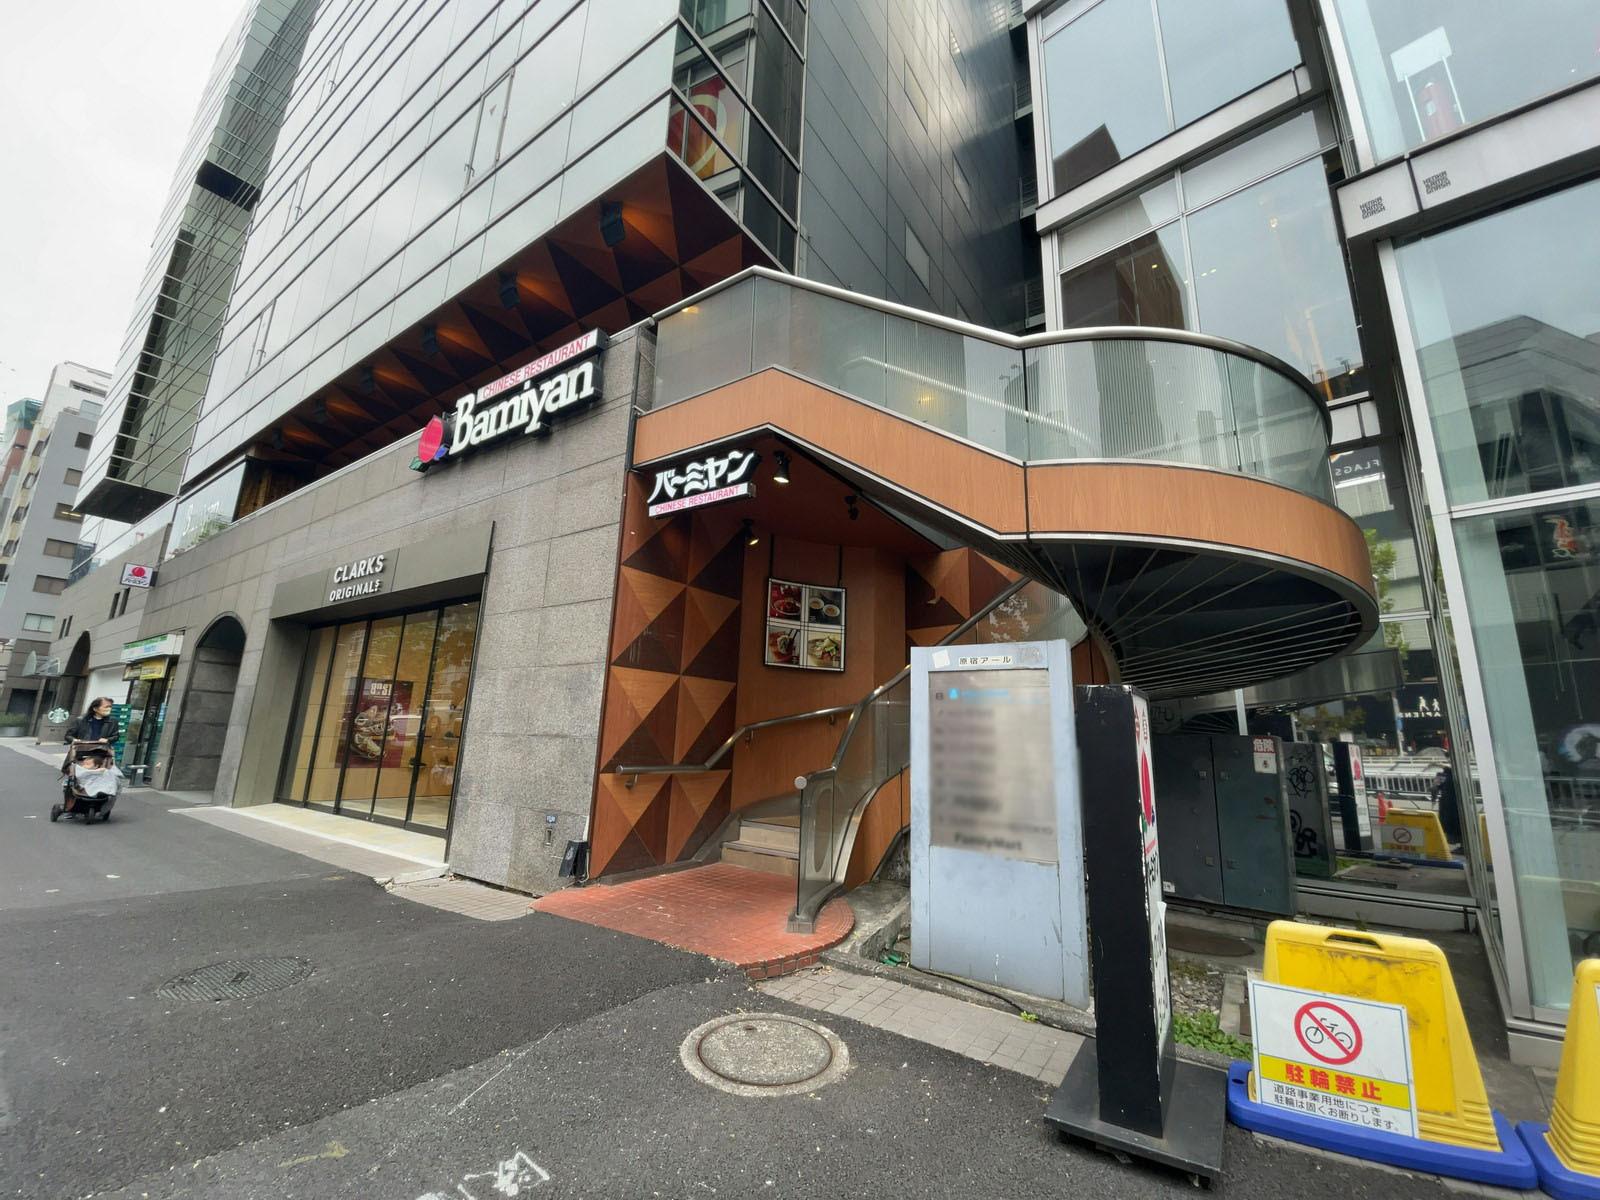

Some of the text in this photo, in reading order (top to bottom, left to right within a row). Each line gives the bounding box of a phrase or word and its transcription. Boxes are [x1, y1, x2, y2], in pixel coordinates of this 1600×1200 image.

[483, 335, 590, 399] CHINESE RESTAURANT
[448, 361, 594, 455] Bamiyan
[647, 450, 755, 504] バーミヤン
[655, 486, 740, 515] CHINESE RESTAURANT
[334, 554, 384, 583] CLARKS
[329, 579, 380, 602] ORIGINALS
[959, 655, 1012, 666] 原宿アール
[1273, 1083, 1382, 1117] 道路事業用地につき
[1285, 1063, 1383, 1102] 駐輪禁止
[1273, 1094, 1399, 1132] 駐輪は固くお断りします。
